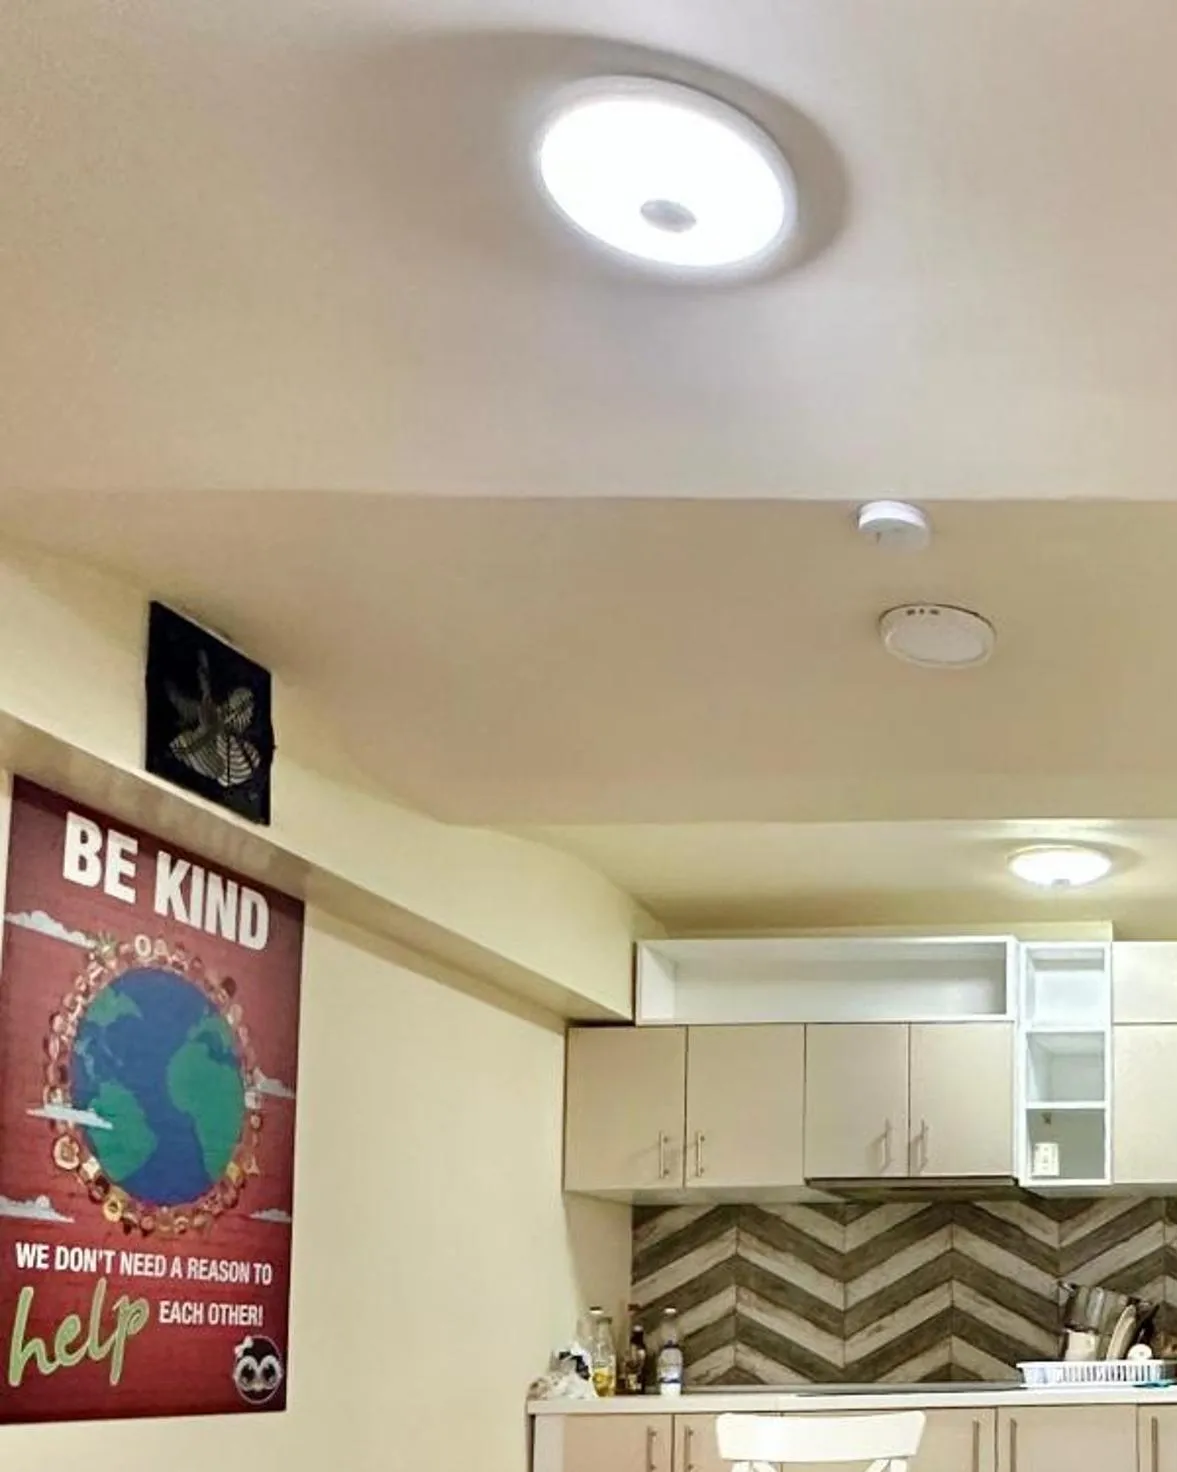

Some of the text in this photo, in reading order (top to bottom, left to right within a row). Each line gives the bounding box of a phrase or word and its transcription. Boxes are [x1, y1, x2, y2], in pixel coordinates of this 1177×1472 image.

[63, 811, 270, 951] BE KIND
[15, 1242, 273, 1286] WE DON'T NEED A REASON TO
[8, 1276, 263, 1387] help EACH OTHER!
